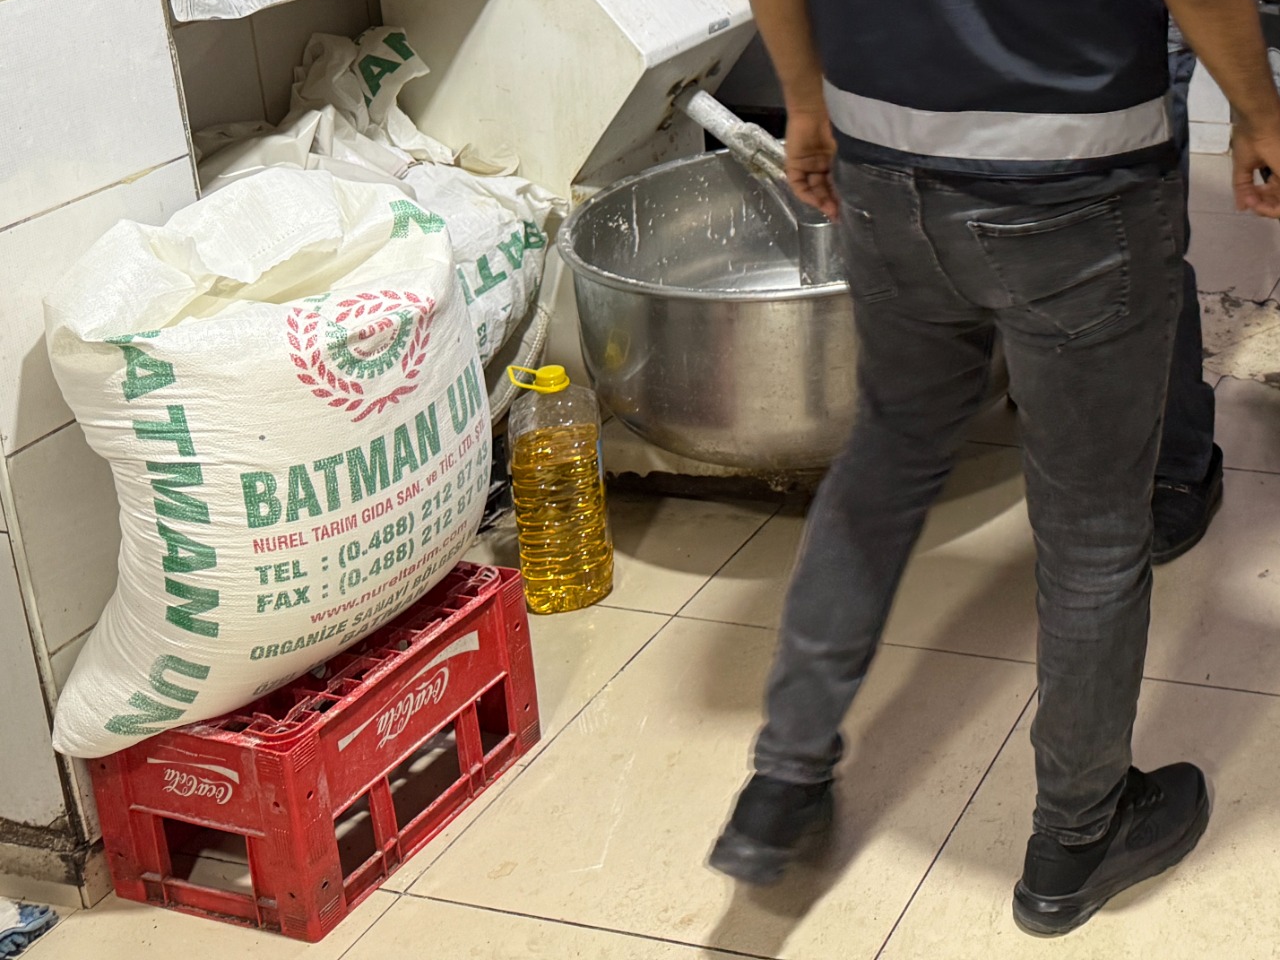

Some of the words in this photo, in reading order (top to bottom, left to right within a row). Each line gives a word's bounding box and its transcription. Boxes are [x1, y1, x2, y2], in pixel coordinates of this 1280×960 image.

[239, 401, 442, 529] BATMAN
[446, 357, 484, 436] UN
[252, 531, 308, 554] NUREL
[311, 514, 358, 542] TARIM
[361, 501, 394, 526] GIDA
[396, 481, 424, 507] SAN.
[426, 470, 438, 487] ve
[458, 434, 474, 459] LTD.
[254, 559, 308, 586] TEL
[338, 511, 415, 569] (0.488)
[421, 481, 453, 521] 212
[456, 458, 473, 490] 87
[256, 585, 311, 614] FAX
[338, 538, 415, 596] (0.488)
[421, 507, 453, 547] 212
[457, 484, 474, 515] 87
[310, 520, 468, 624] www.nureltarim.com
[249, 618, 349, 661] ORGANİZE
[352, 580, 410, 626] SANAYİ
